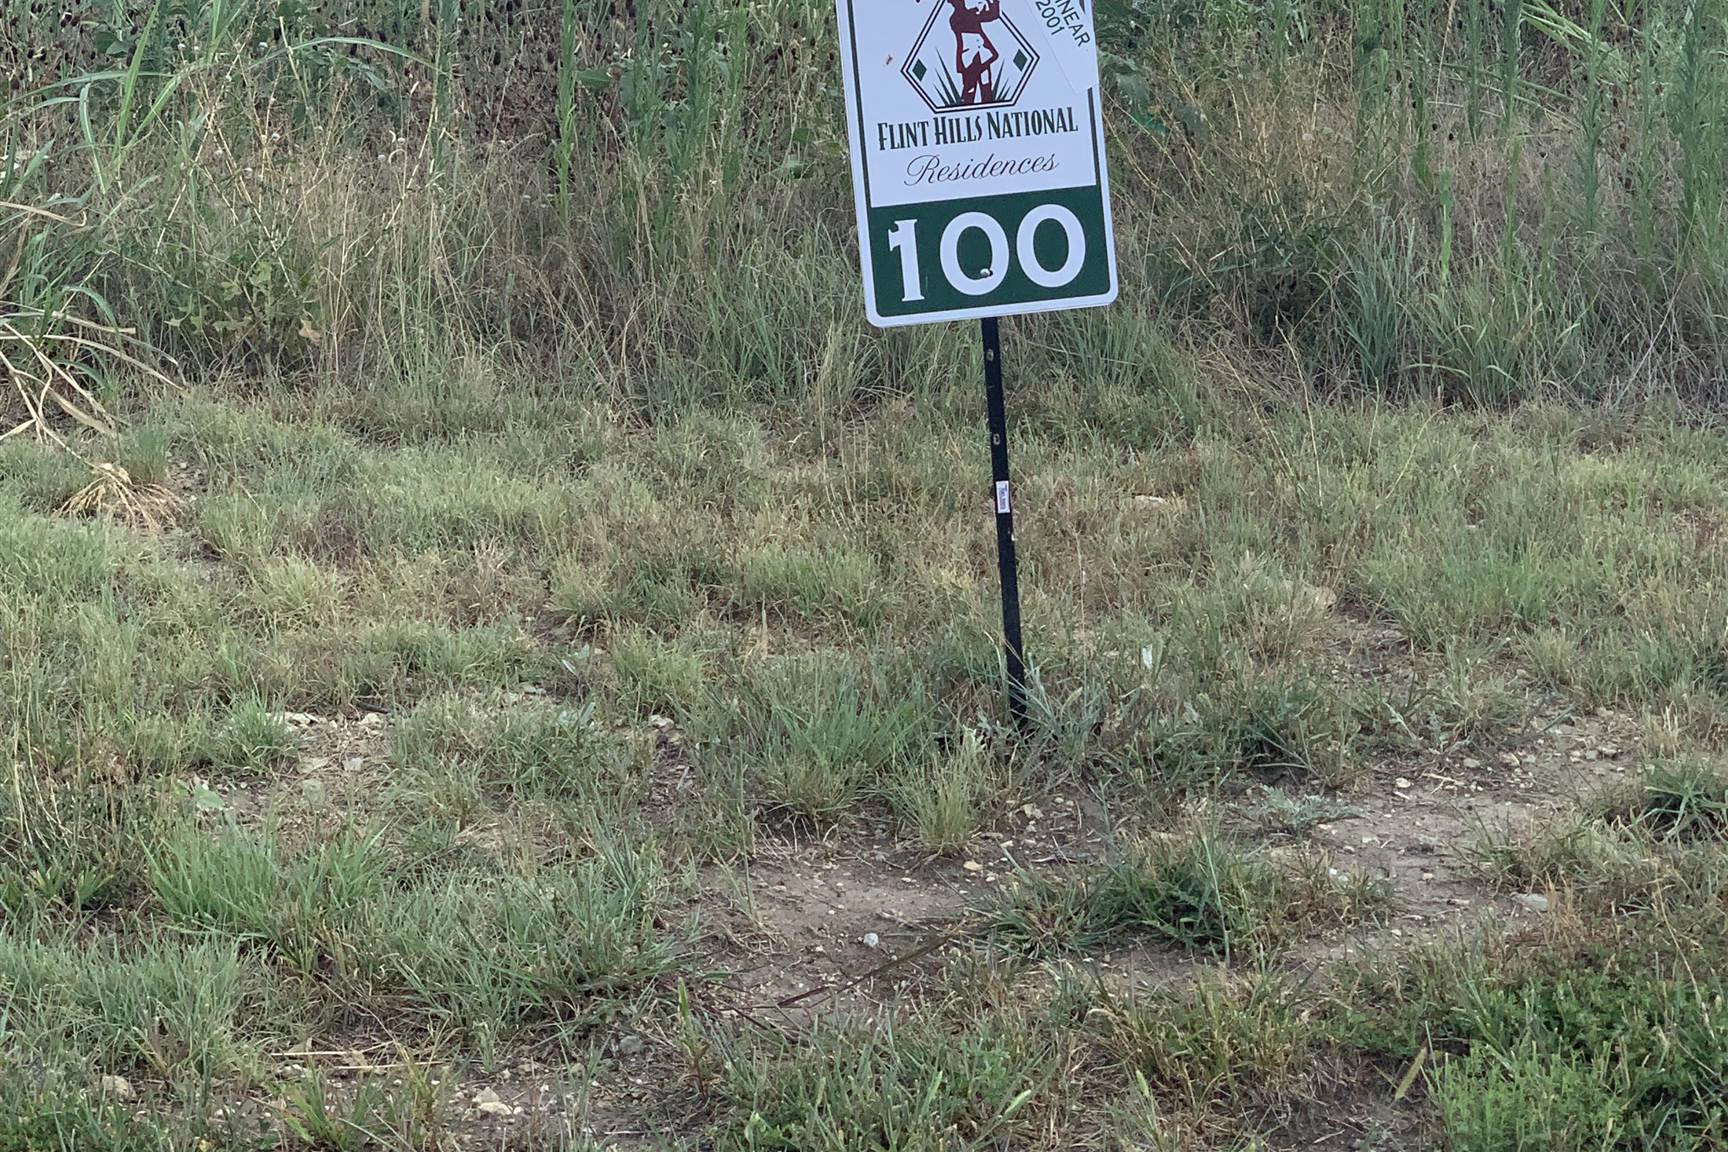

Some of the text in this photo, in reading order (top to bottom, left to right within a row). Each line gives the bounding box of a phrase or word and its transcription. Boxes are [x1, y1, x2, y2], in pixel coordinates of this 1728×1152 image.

[877, 106, 1079, 151] FLINT HILLS NATIONAL
[903, 152, 1060, 186] Residences
[887, 203, 1087, 303] 100
